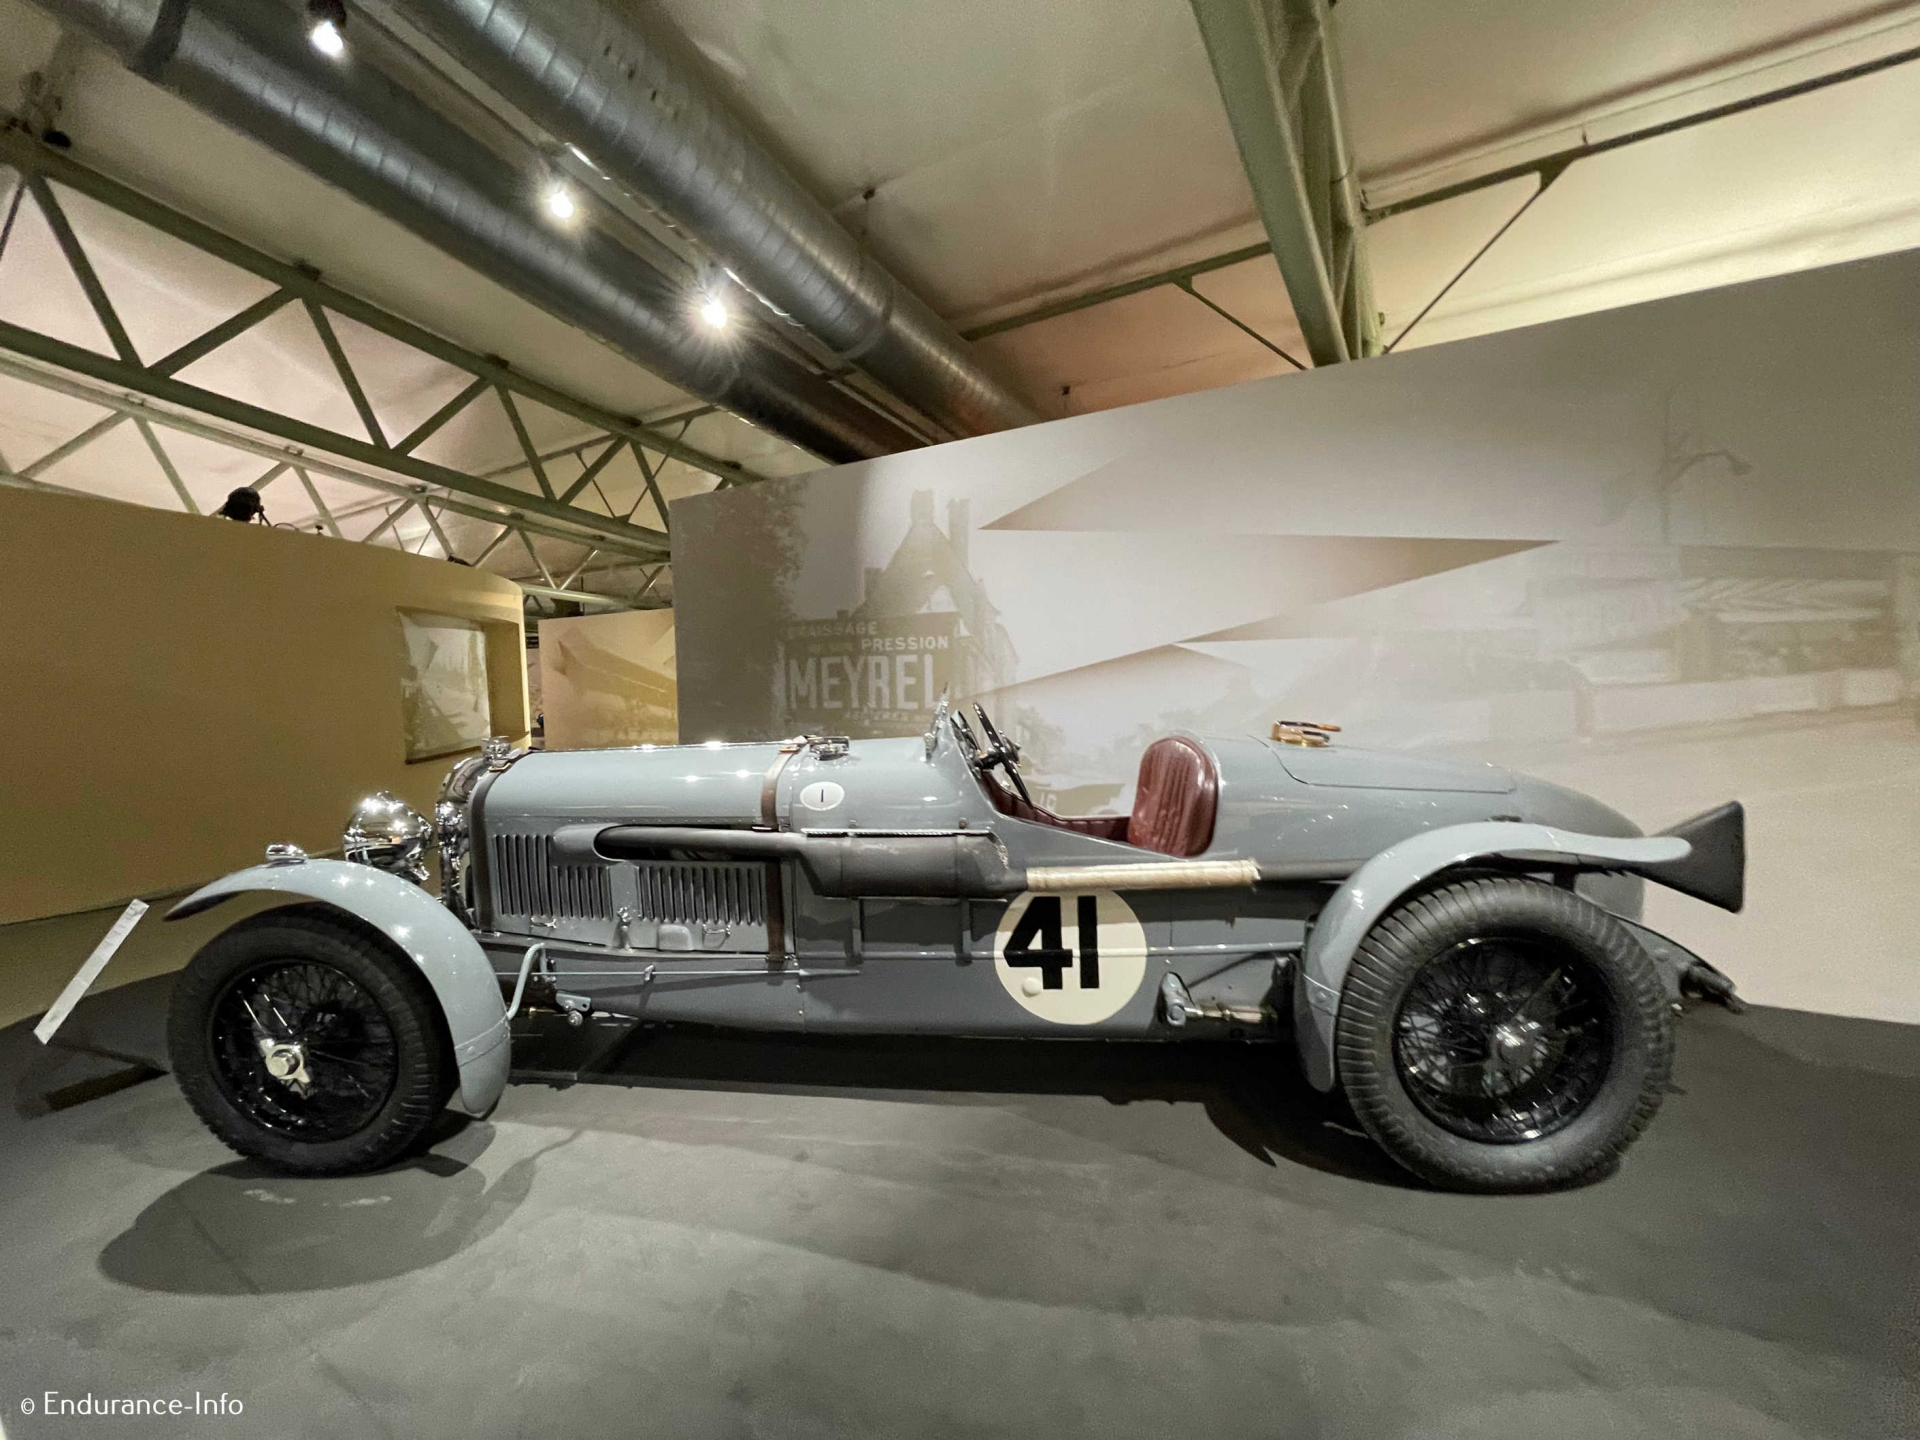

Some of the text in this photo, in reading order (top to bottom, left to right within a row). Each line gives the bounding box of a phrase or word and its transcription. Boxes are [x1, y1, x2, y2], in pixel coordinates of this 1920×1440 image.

[861, 635, 949, 651] PRESSION
[788, 653, 941, 711] MEYREL
[1003, 896, 1100, 990] 41
